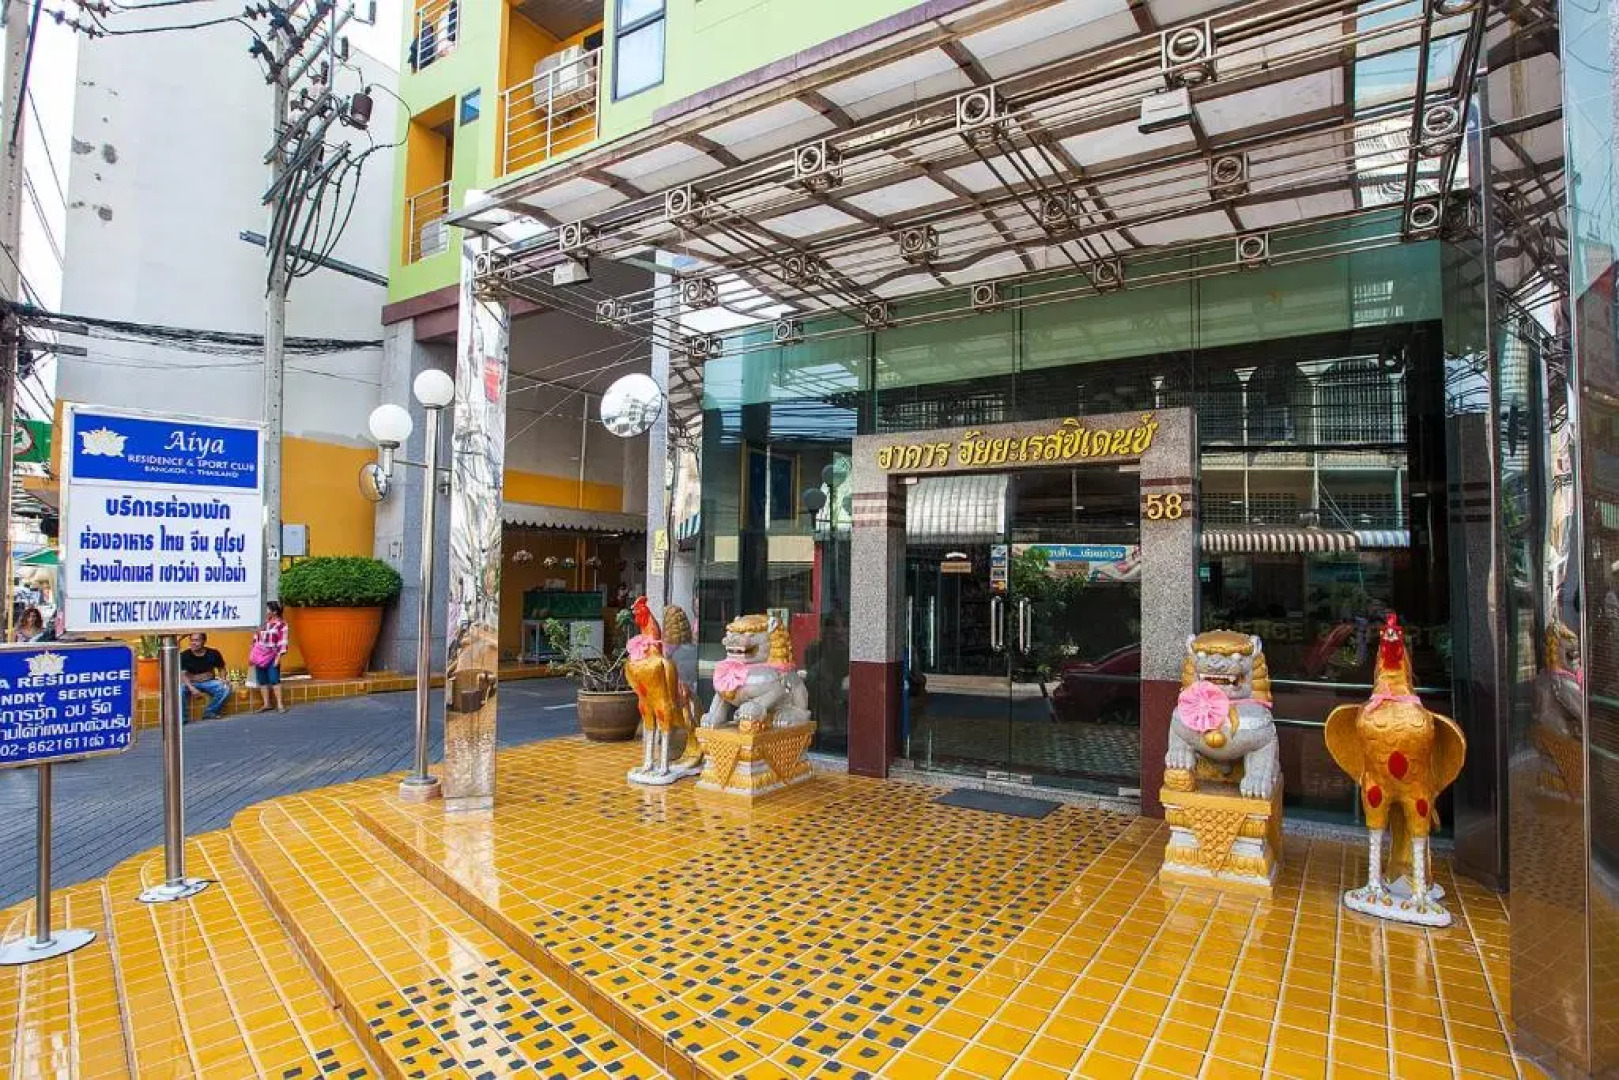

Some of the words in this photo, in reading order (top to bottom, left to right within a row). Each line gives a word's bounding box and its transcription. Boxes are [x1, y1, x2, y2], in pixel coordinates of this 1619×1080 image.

[164, 431, 225, 458] Aiya
[878, 442, 951, 470] อาคาร
[127, 453, 184, 466] RESIDENCE
[186, 458, 194, 467] &
[197, 458, 228, 470] SPORT
[230, 461, 255, 472] CLUB
[144, 466, 187, 476] BANGKOK
[197, 468, 239, 479] THAILAND
[105, 494, 231, 520] บริการห้องพัก
[1146, 493, 1183, 520] 58
[79, 525, 154, 551] ห้องอาหาร
[160, 525, 184, 551] ไทย
[190, 530, 209, 552] จีน
[214, 527, 246, 558] ยุโรป
[204, 556, 246, 582] อบไอน้ำ
[89, 600, 146, 624] INTERNET
[148, 600, 171, 621] LOW
[173, 600, 202, 621] PRICE
[203, 603, 220, 620] 24
[221, 603, 241, 620] hrs.
[17, 669, 131, 689] RESIDENCE
[58, 685, 122, 700] SERVICE
[0, 703, 57, 723] การซัก
[65, 704, 86, 718] อบ
[91, 699, 112, 716] รีด
[109, 732, 131, 745] 141
